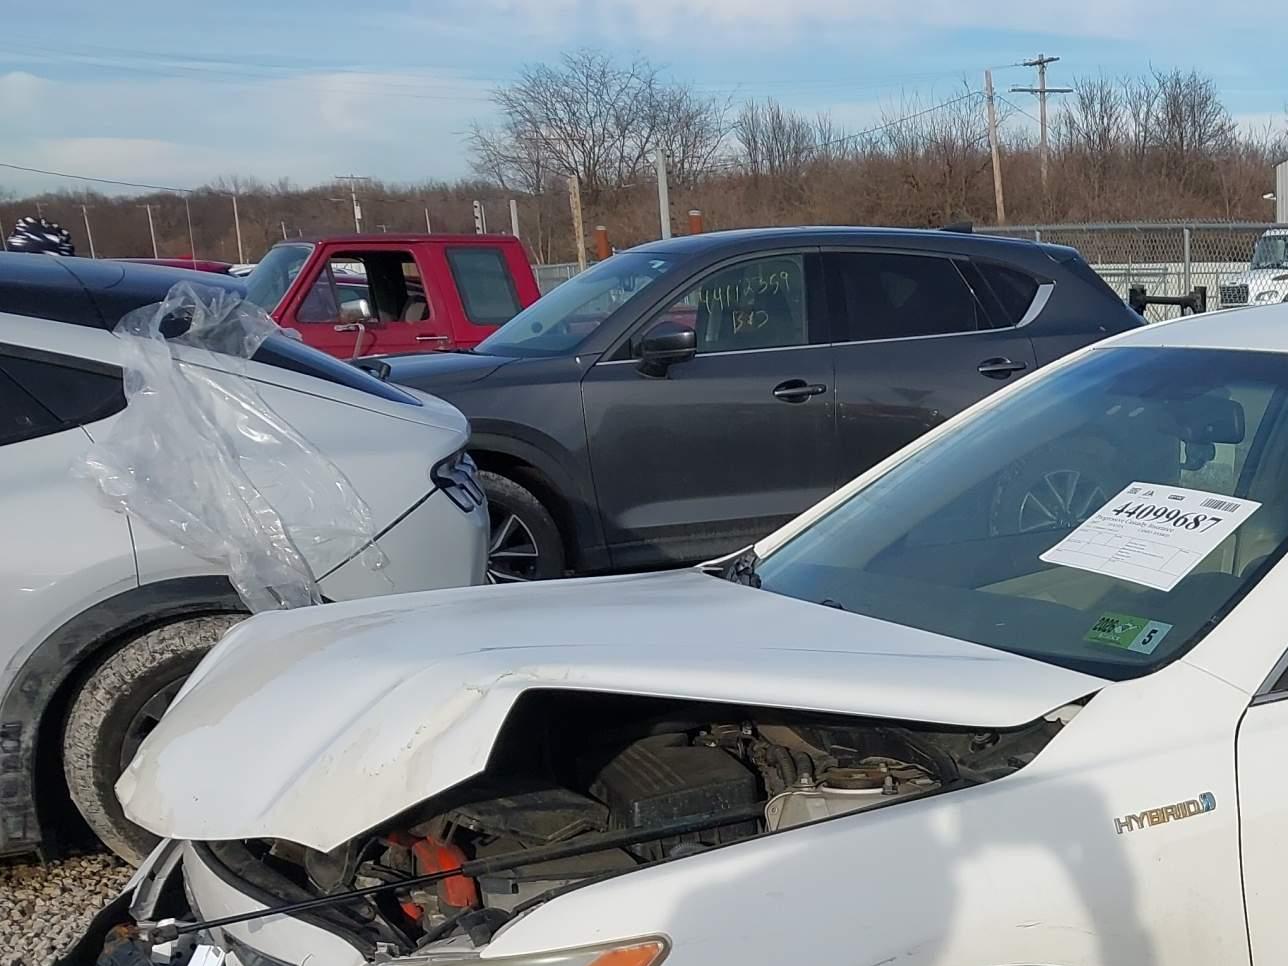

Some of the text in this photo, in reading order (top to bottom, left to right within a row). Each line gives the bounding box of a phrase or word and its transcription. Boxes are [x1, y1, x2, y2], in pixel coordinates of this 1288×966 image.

[1112, 501, 1223, 533] 44099687
[1142, 629, 1159, 645] 5
[1113, 799, 1203, 834] HYBRID
